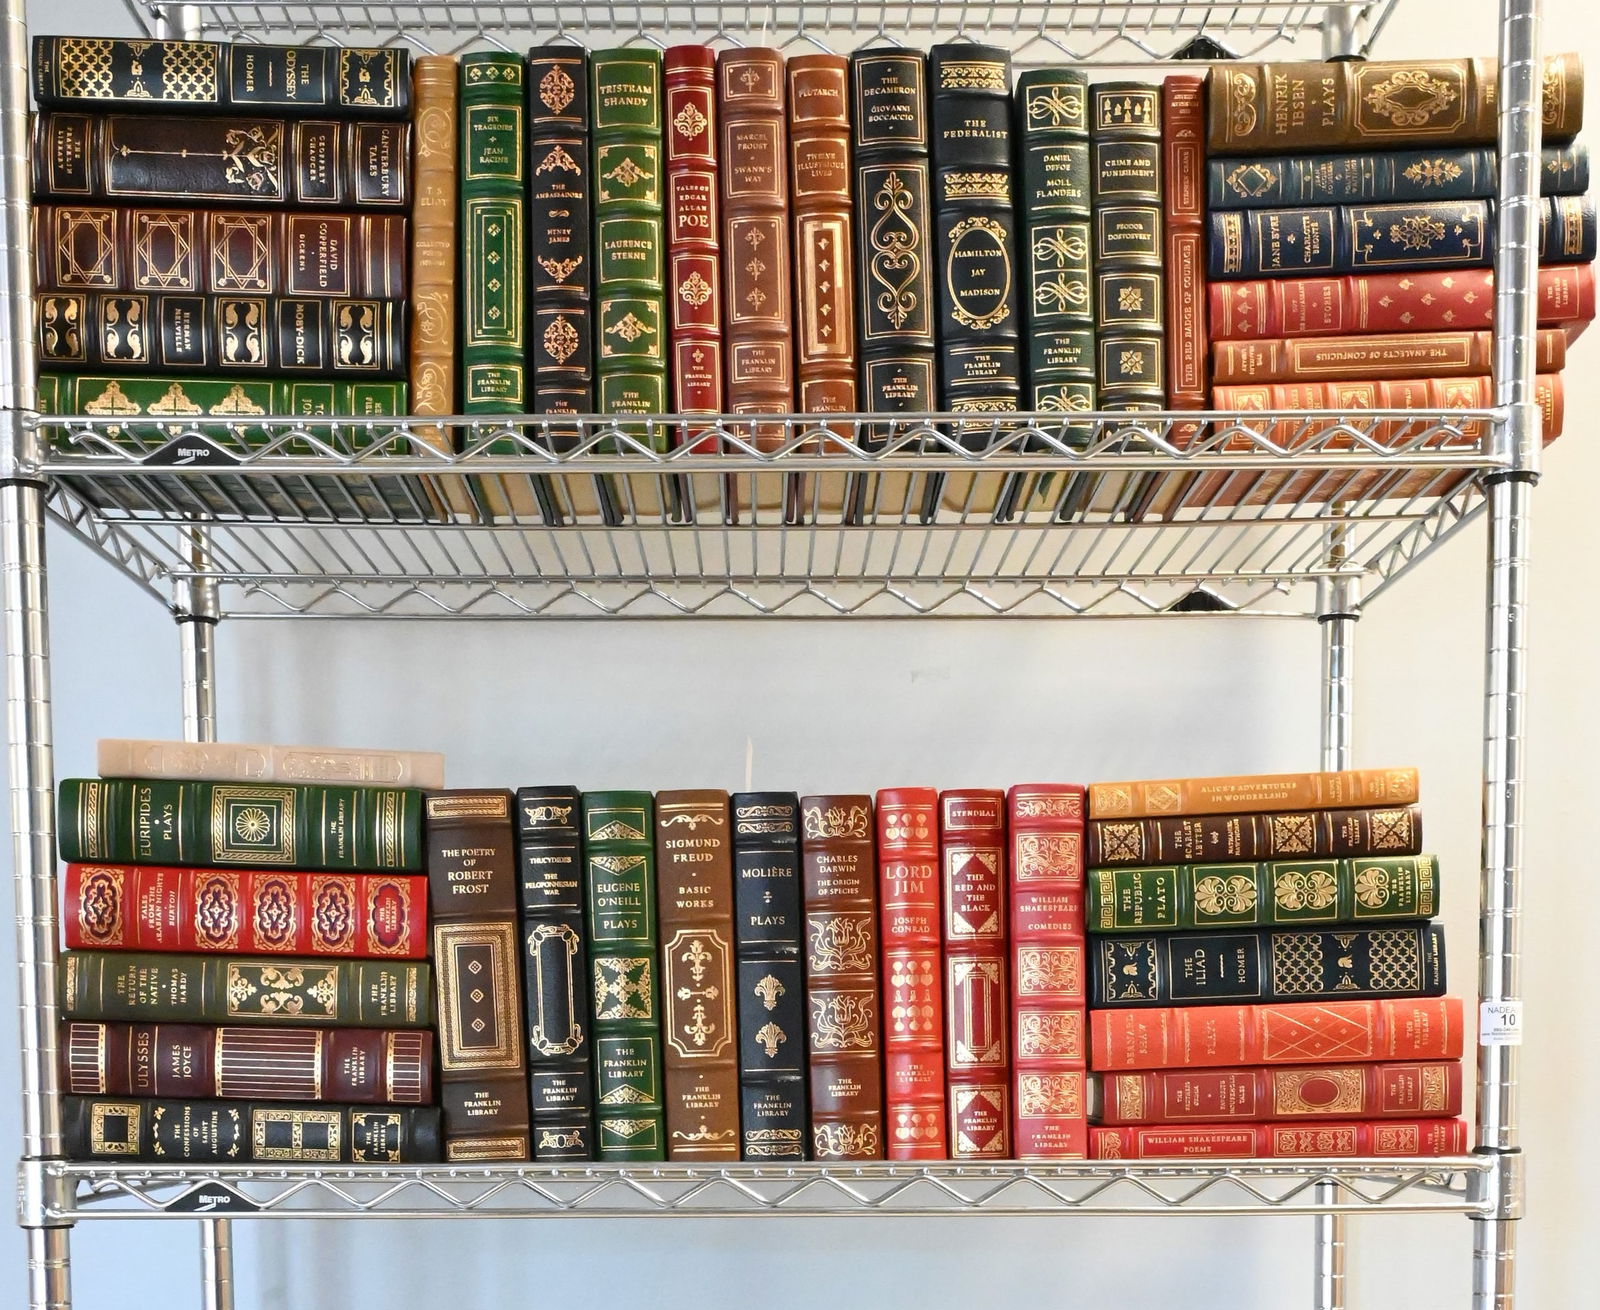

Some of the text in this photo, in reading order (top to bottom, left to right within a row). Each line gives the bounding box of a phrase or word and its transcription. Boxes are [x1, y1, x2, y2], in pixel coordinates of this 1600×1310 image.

[286, 50, 296, 99] ODYSSEY
[600, 85, 651, 94] TRISTRAM
[864, 87, 916, 96] DECAMERON
[604, 97, 648, 106] SHANDY
[1275, 74, 1287, 134] HENRIK
[1292, 79, 1304, 126] IBSEN
[1322, 77, 1334, 126] PLAYS
[871, 105, 910, 114] GIOVANNI
[869, 113, 914, 122] BOCCACCIO
[944, 130, 1008, 139] FEDERALIST
[380, 129, 389, 196] CANTERBURY
[1105, 159, 1130, 168] CRIME
[1047, 179, 1071, 187] MOLL
[1036, 189, 1081, 198] FLANDERS
[679, 214, 709, 228] POE
[605, 240, 652, 250] LAURENCE
[955, 250, 1002, 258] HAMILTON
[971, 269, 985, 277] JAY
[961, 288, 1000, 296] MADISON
[296, 304, 304, 364] MOBY-DICK
[1431, 348, 1448, 356] THE
[178, 448, 210, 456] METRO
[1237, 782, 1296, 791] ADVENTURES
[1224, 792, 1288, 801] WONDERLAND
[952, 809, 996, 818] STENDHAL
[140, 787, 151, 856] EURIPIDES
[163, 804, 172, 840] PLAYS
[666, 838, 720, 848] SIGMUND
[674, 853, 713, 862] FREUD
[817, 855, 858, 864] CHARLES
[742, 867, 792, 878] MOLIÈRE
[820, 864, 856, 873] DARWIN
[886, 867, 932, 879] LORD
[448, 871, 492, 881] ROBERT
[453, 884, 488, 894] FROST
[598, 883, 640, 893] EUGENE
[679, 886, 711, 894] BASIC
[894, 880, 924, 894] JIM
[598, 897, 641, 906] O'NEILL
[1157, 878, 1166, 919] PLATO
[676, 899, 714, 908] WORKS
[961, 904, 990, 912] BLACK
[604, 920, 637, 929] PLAYS
[751, 916, 785, 926] PLAYS
[1196, 949, 1206, 984] ILIAD
[140, 992, 146, 1004] OF
[1500, 1014, 1516, 1026] 10
[138, 1032, 149, 1088] ULYSSES
[183, 1046, 192, 1078] JOYCE
[199, 1195, 230, 1204] METRO
